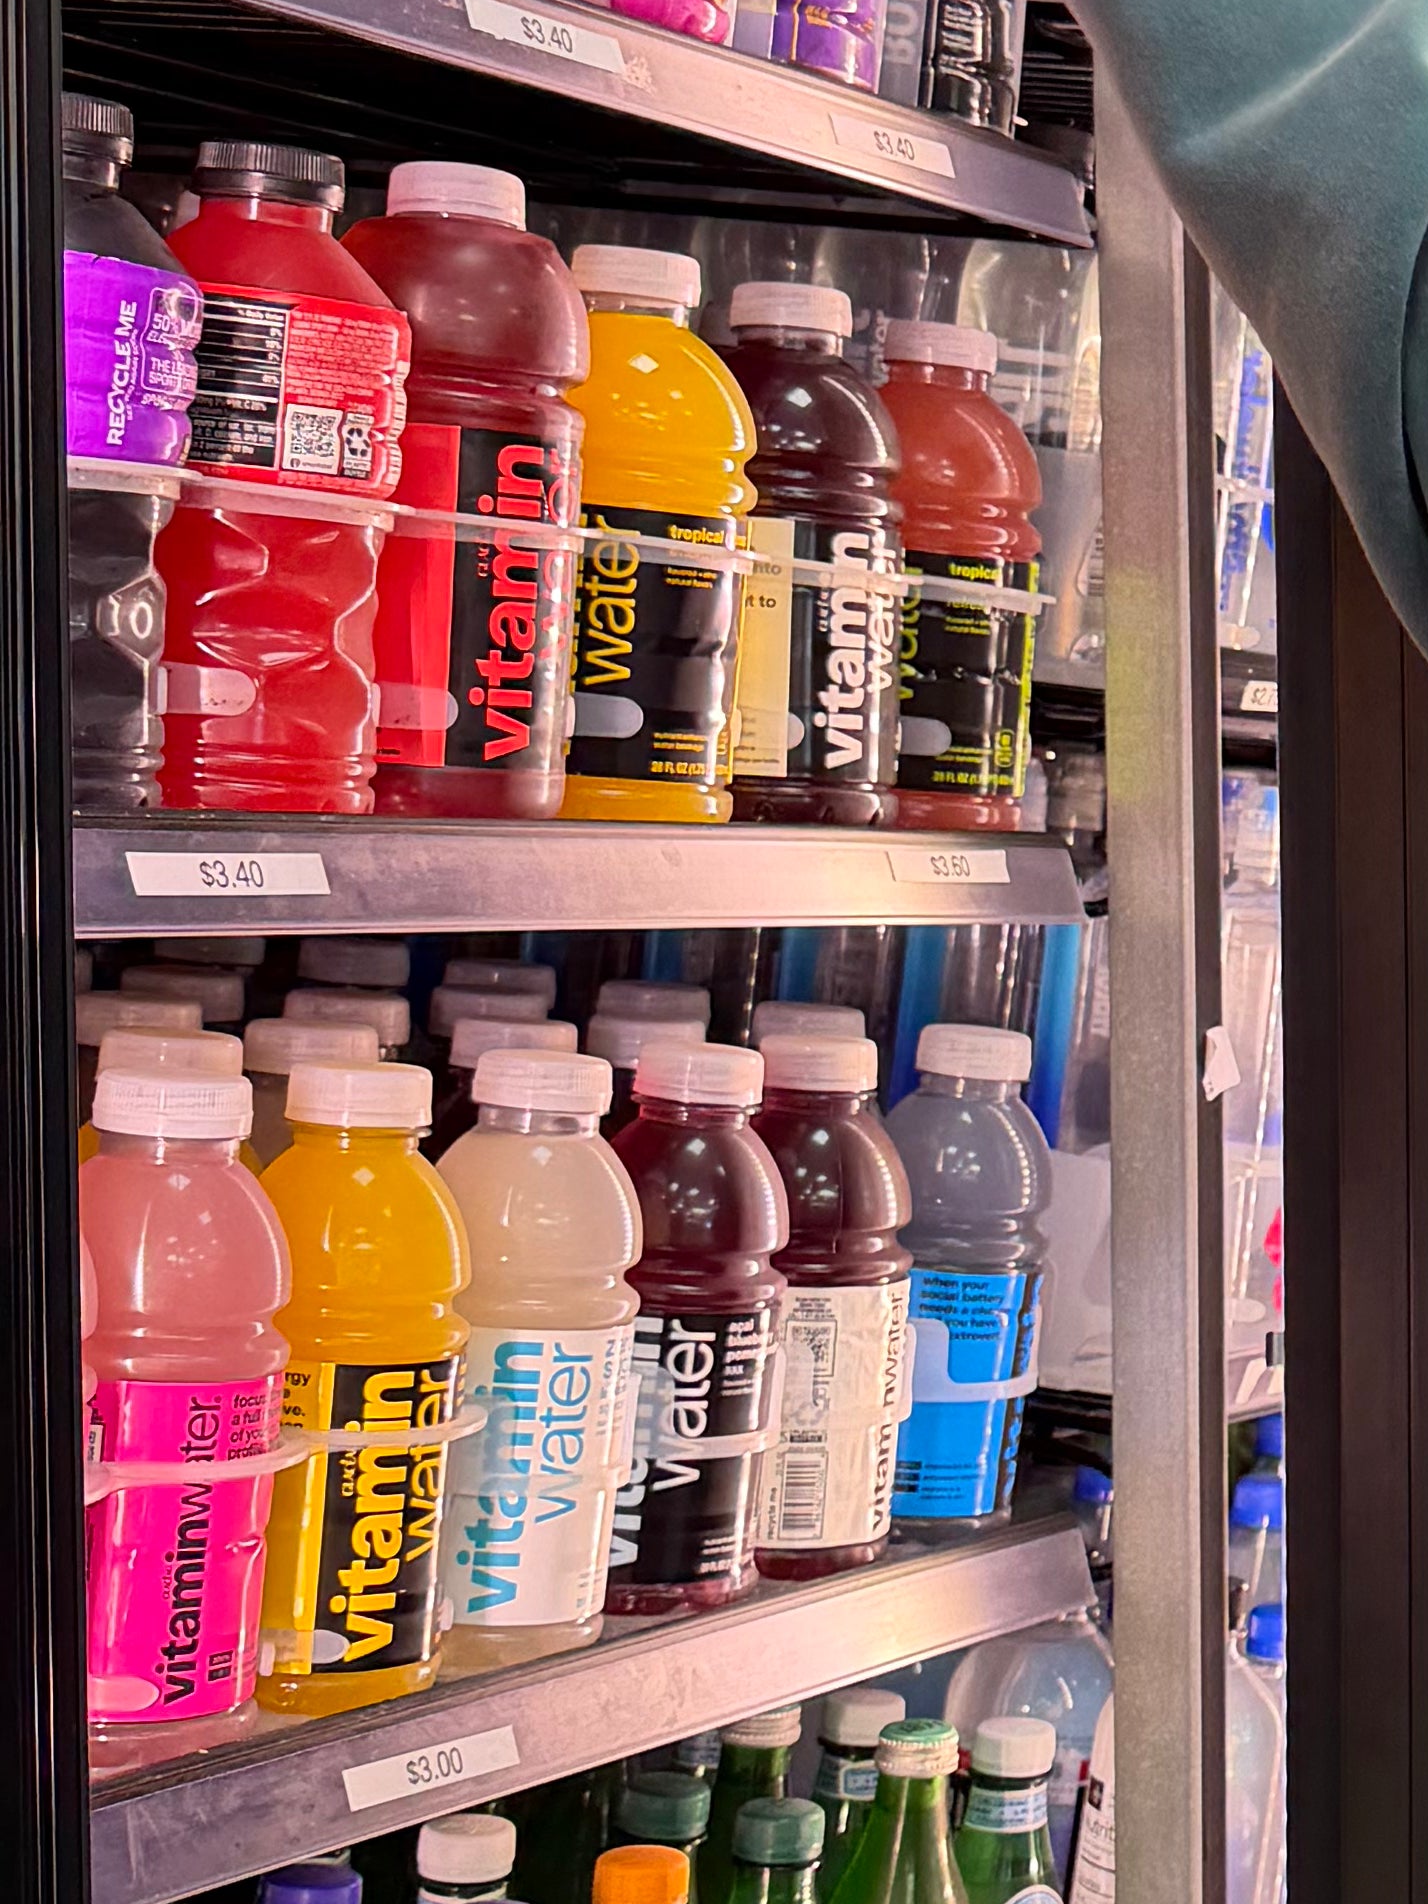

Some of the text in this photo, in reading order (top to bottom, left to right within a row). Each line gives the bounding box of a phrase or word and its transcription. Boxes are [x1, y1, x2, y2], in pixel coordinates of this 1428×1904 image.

[520, 17, 575, 54] $3.40
[873, 130, 917, 162] $3.40
[106, 336, 133, 446] RECYCLE
[116, 299, 138, 336] ME
[468, 443, 546, 761] vitamin
[582, 514, 641, 686] water
[667, 524, 726, 545] tropical
[814, 531, 870, 771] vitamin
[866, 547, 897, 694] water
[199, 858, 265, 892] $3.40
[404, 1365, 452, 1564] water
[457, 1340, 545, 1614] vitamin
[533, 1341, 594, 1524] water
[329, 1369, 417, 1664] vitamin
[407, 1746, 464, 1786] $3.00
